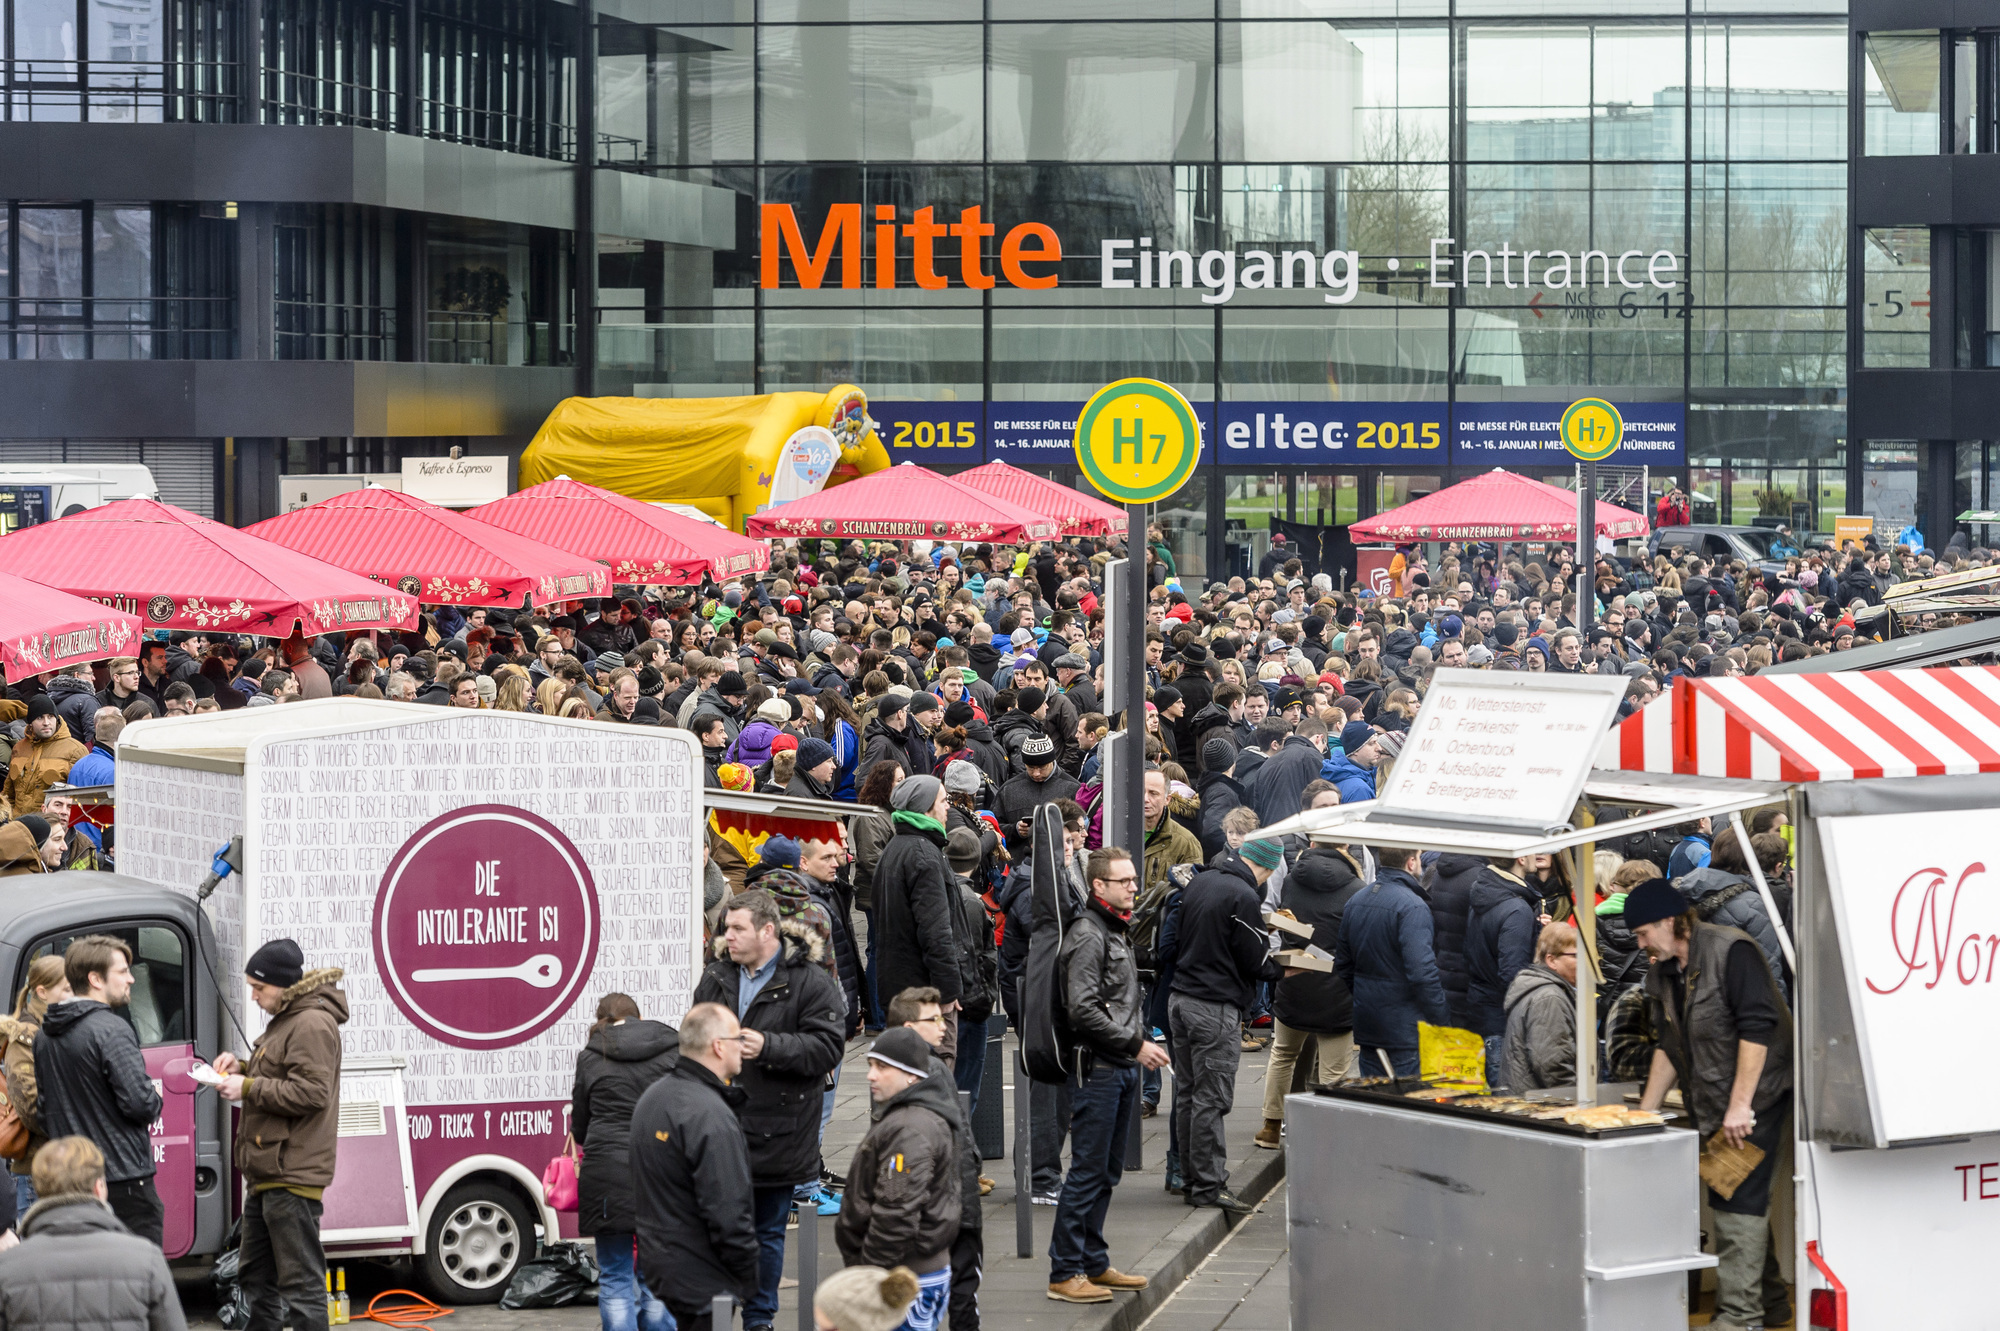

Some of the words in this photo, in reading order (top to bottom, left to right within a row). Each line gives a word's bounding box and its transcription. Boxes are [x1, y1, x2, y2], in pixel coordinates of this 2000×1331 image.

[760, 203, 1062, 290] Mitte
[1100, 237, 1359, 304] Eingang
[1430, 238, 1677, 289] Entrance
[1618, 291, 1638, 319] 6
[893, 421, 976, 448] 2015
[994, 421, 1010, 430] DIE
[1011, 421, 1042, 430] MESSE
[1043, 418, 1061, 430] FÜR
[1226, 413, 1348, 449] eltec
[1357, 421, 1441, 449] 2015
[1460, 422, 1475, 431] DIE
[1477, 422, 1507, 431] MESSE
[1510, 420, 1528, 431] FÜR
[994, 439, 1008, 448] 14.
[1018, 439, 1031, 448] 16.
[1032, 439, 1070, 449] JANUAR
[1460, 440, 1473, 450] 14.
[1484, 440, 1496, 450] 16.
[1498, 440, 1537, 450] JANUAR
[1623, 438, 1676, 450] NÜRNBERG
[419, 461, 446, 477] Kaffee
[446, 462, 454, 474] &
[456, 462, 492, 478] Espresso
[842, 520, 926, 536] SCHANZENBRÄU
[1437, 524, 1514, 539] SCHANZENBRÄU
[342, 597, 380, 622] SCHANZENBRÄU
[53, 624, 98, 660] SCHANZENBRÄU
[640, 680, 664, 695] NORTH
[1438, 696, 1458, 710] Mo.
[1466, 696, 1547, 714] Wettersteinstr.
[456, 716, 513, 740] VEGETARISCH
[518, 718, 547, 738] VEGAN
[1428, 716, 1443, 732] Di.
[1456, 718, 1520, 735] Frankenstr.
[262, 744, 308, 767] SMOOTHIES
[314, 744, 358, 766] WHOOPIES
[362, 743, 397, 766] GESUND
[402, 743, 461, 766] HISTAMINARM
[466, 742, 510, 765] MILCHFREI
[515, 742, 540, 764] EIFREI
[547, 741, 600, 764] WEIZENFREI
[605, 740, 660, 764] VEGETARISCH
[1418, 738, 1435, 754] Mi.
[1446, 740, 1516, 757] Ochenbruck
[261, 770, 304, 793] SAISONAL
[310, 770, 368, 792] SANDWICHES
[372, 770, 406, 792] SALATE
[411, 768, 458, 792] SMOOTHIES
[463, 768, 504, 790] WHOOPIES
[510, 768, 544, 790] GESUND
[549, 766, 606, 790] HISTAMINARM
[611, 766, 654, 788] MILCHFREI
[660, 766, 684, 788] EIFREI
[1409, 759, 1428, 774] Do.
[1438, 760, 1506, 778] Aufseßplatz
[1400, 780, 1414, 794] Fr.
[1426, 781, 1519, 801] Brettergartenstr.
[261, 797, 292, 820] SEARM
[297, 796, 350, 820] GLUTENFREI
[355, 796, 386, 818] FRISCH
[391, 796, 432, 818] REGIONAL
[547, 792, 580, 815] SALATE
[584, 792, 629, 814] SMOOTHIES
[635, 791, 676, 814] WHOOPIES
[261, 822, 290, 846] VEGAN
[296, 822, 337, 846] SOJAFREI
[342, 822, 398, 844] LAKTOSEFREI
[562, 817, 602, 840] REGIONAL
[608, 817, 648, 840] SAISONAL
[260, 848, 287, 872] EIFREI
[294, 848, 348, 872] WEIZENFREI
[622, 842, 672, 866] GLUTENFREI
[260, 876, 295, 899] GESUND
[301, 875, 360, 898] HISTAMINARM
[602, 868, 640, 890] SOJAFREI
[475, 860, 500, 896] DIE
[260, 902, 284, 925] CHES
[289, 901, 322, 924] SALATE
[328, 900, 374, 924] SMOOTHIES
[610, 892, 662, 916] WEIZENFREI
[297, 928, 339, 950] REGIONAL
[629, 918, 686, 940] HISTAMINARM
[418, 906, 528, 946] INTOLERANTE
[539, 906, 558, 942] ISI
[621, 944, 652, 966] SALATE
[623, 970, 663, 992] REGIONAL
[351, 1004, 378, 1028] EIFREI
[361, 1030, 395, 1053] GESUND
[409, 1053, 455, 1076] SMOOTHIES
[461, 1052, 502, 1075] WHOOPIES
[508, 1050, 542, 1074] GESUND
[437, 1078, 478, 1100] SAISONAL
[484, 1076, 540, 1100] SANDWICHES
[407, 1114, 432, 1140] FOOD
[440, 1113, 474, 1139] TRUCK
[500, 1110, 552, 1136] CATERING
[154, 1144, 165, 1162] DE
[1954, 1162, 2000, 1202] TE
